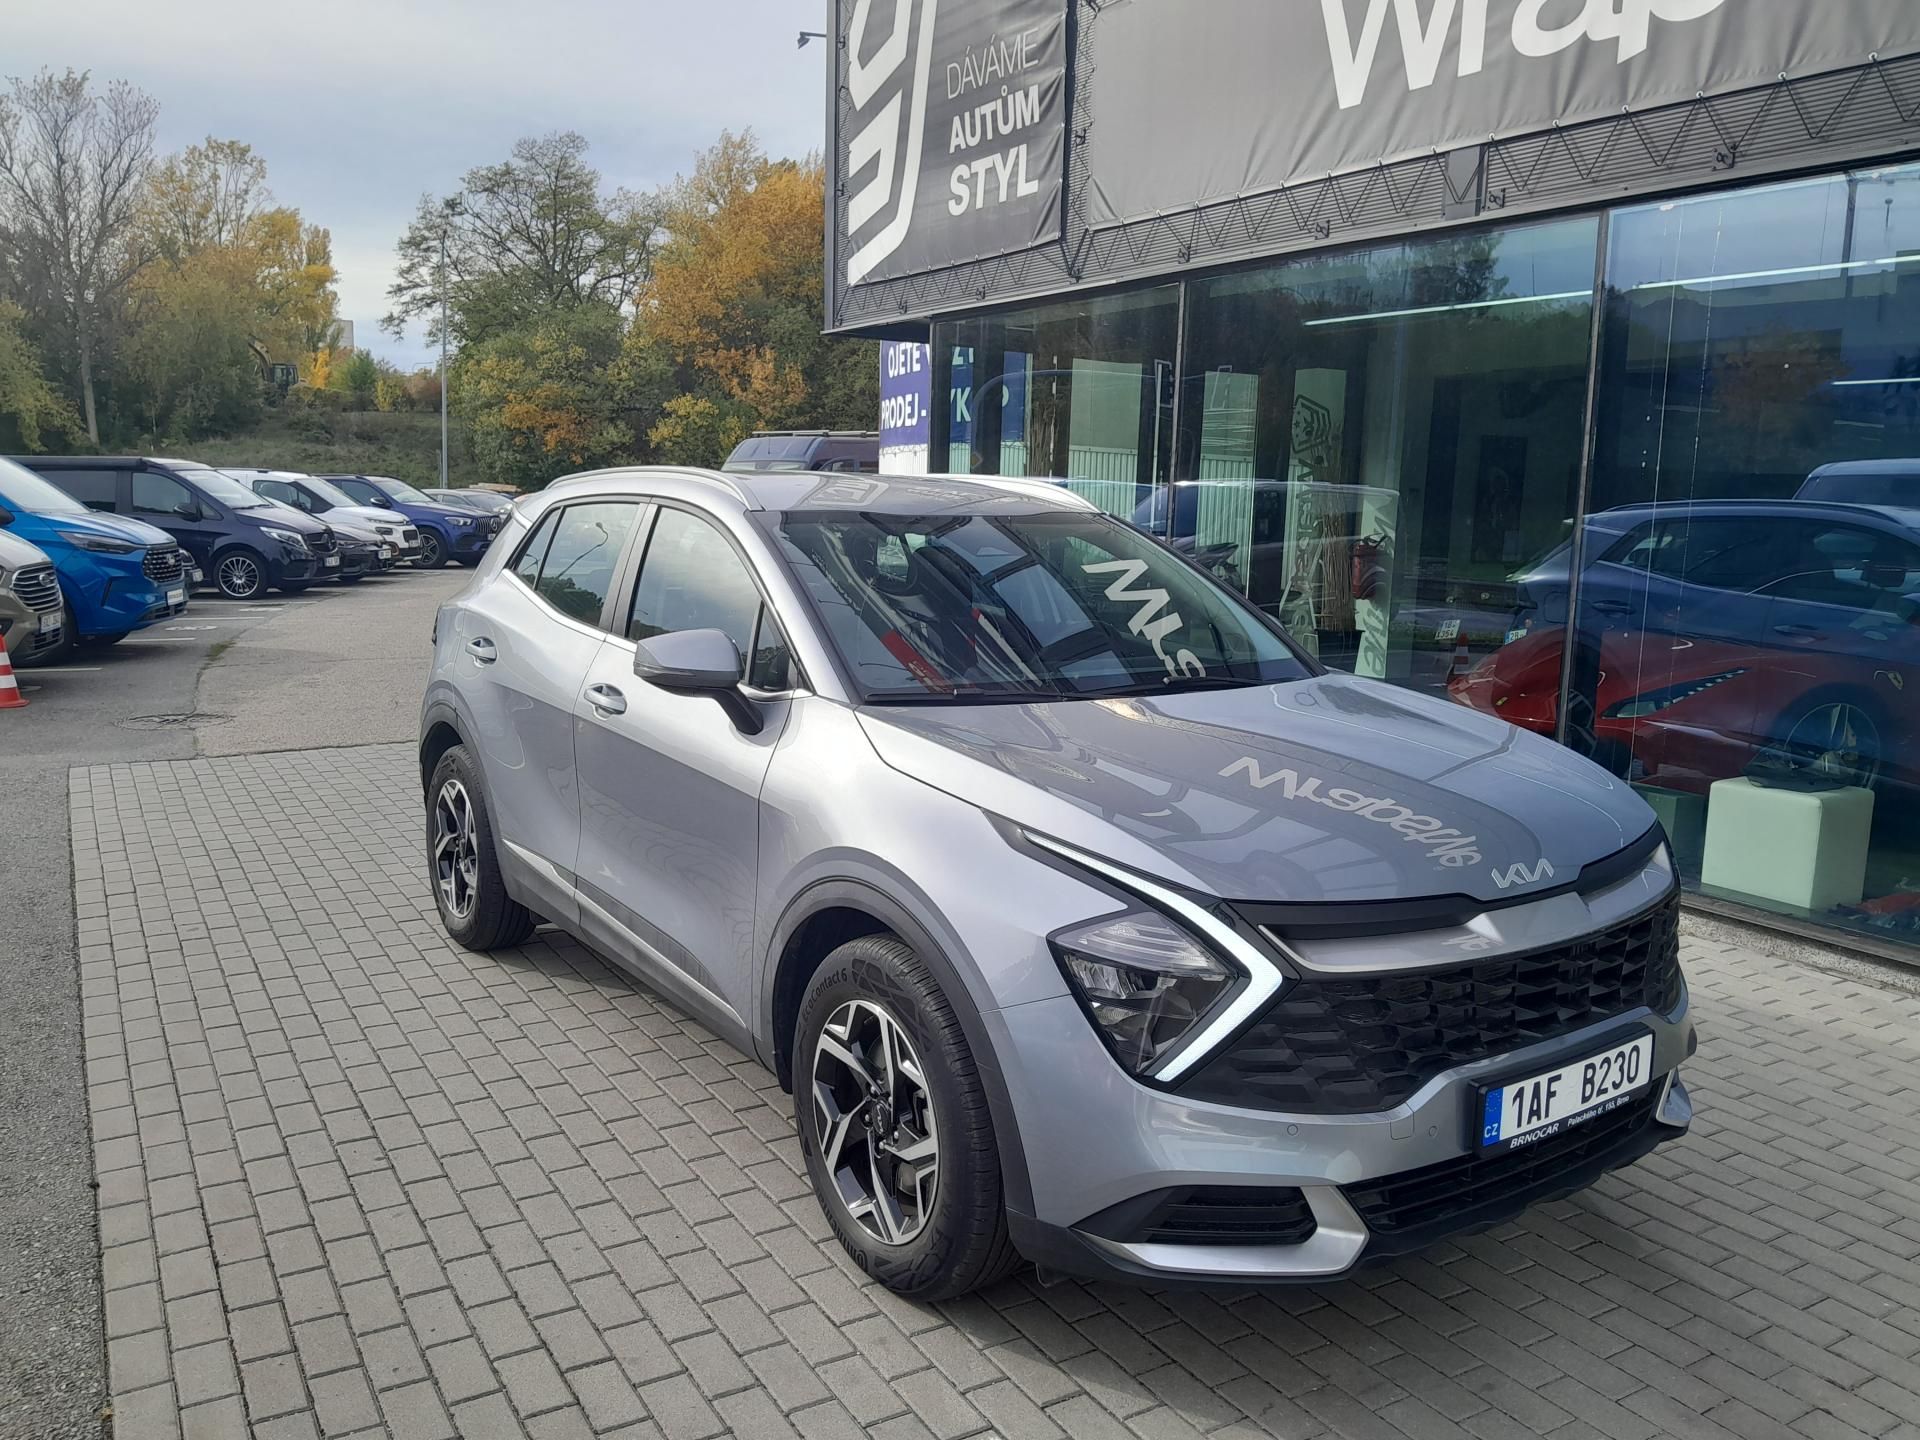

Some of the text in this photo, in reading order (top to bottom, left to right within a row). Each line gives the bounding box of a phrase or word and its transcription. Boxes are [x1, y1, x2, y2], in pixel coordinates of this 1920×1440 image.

[947, 28, 1039, 99] DÁVÁME
[949, 84, 1040, 154] AUTŮM
[948, 143, 1039, 216] STYL
[881, 393, 918, 430] PRODEJ
[1491, 858, 1554, 888] KIA
[1512, 1044, 1640, 1129] 1AF B230
[1484, 1123, 1498, 1138] CZ
[1510, 1122, 1560, 1149] BRNOCAR
